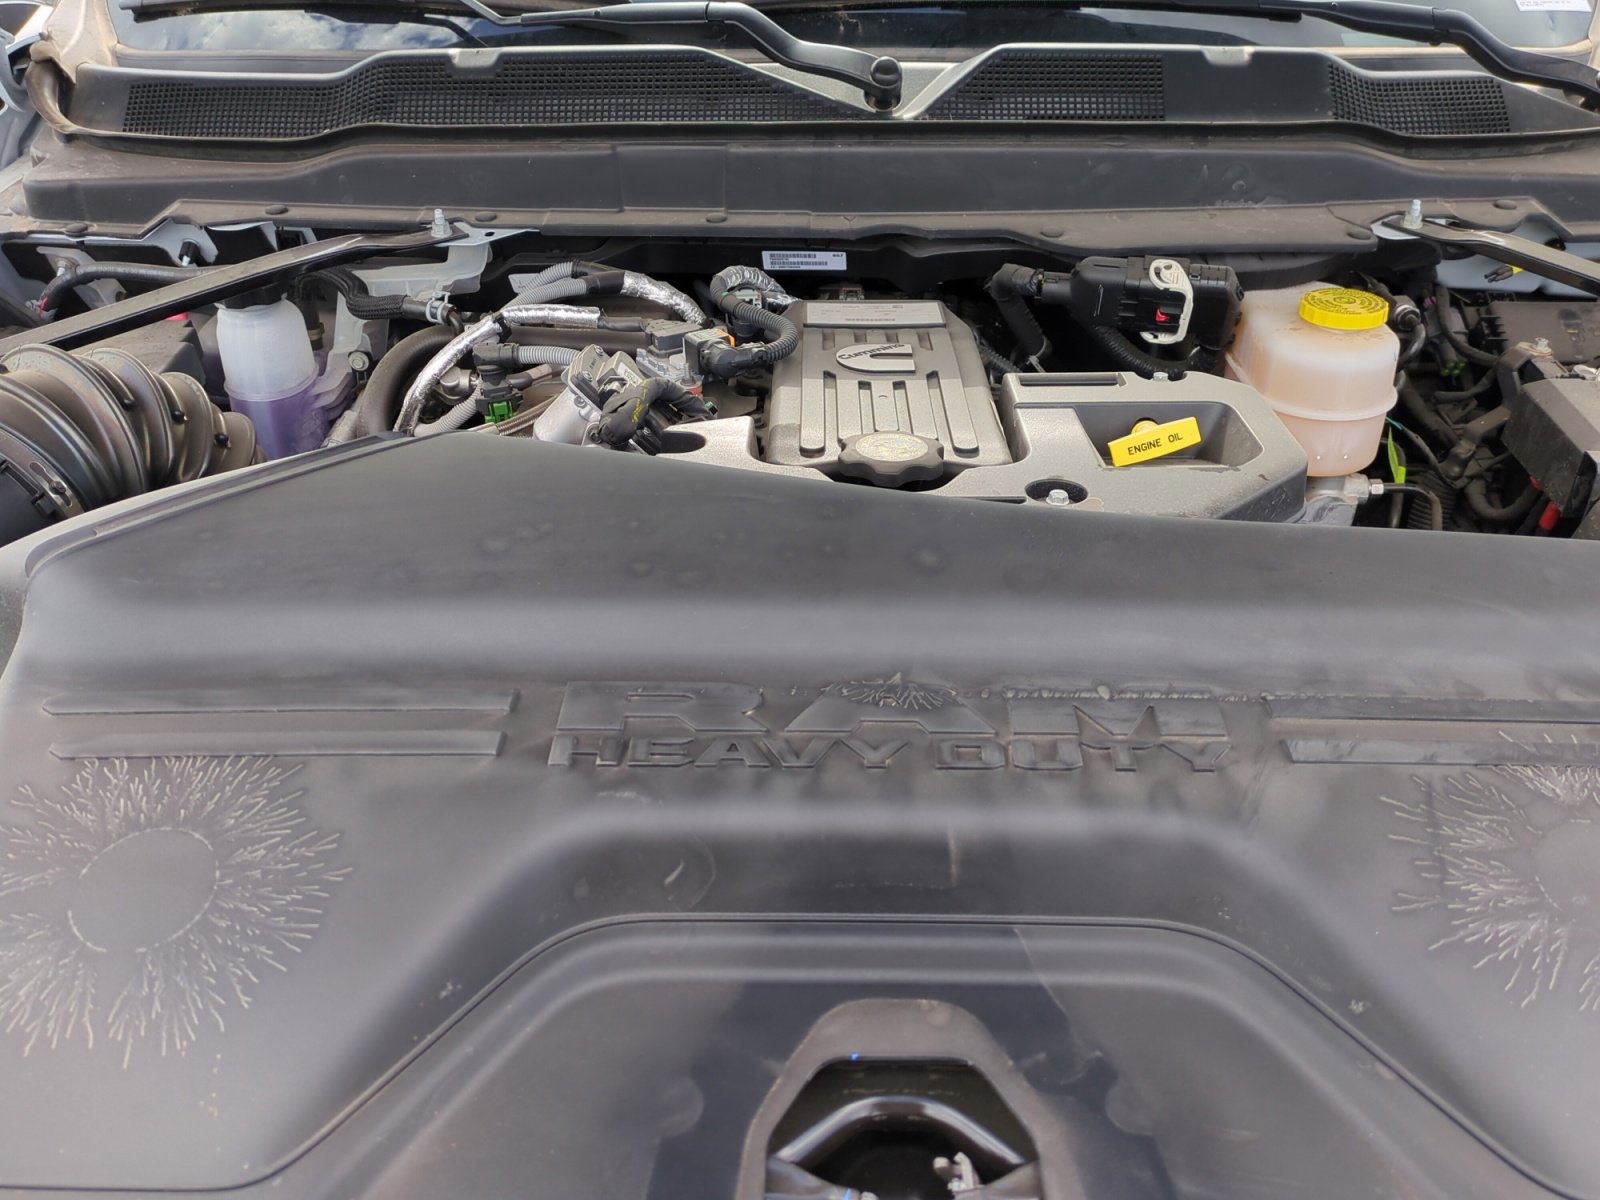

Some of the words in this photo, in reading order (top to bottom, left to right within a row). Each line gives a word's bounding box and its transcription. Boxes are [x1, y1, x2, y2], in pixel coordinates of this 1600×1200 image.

[838, 344, 905, 360] Cummins
[1127, 438, 1162, 456] ENGINE
[1168, 432, 1183, 443] OIL
[556, 680, 1228, 737] RAM
[547, 735, 910, 768] HEAVY
[935, 739, 1232, 773] DUTY
